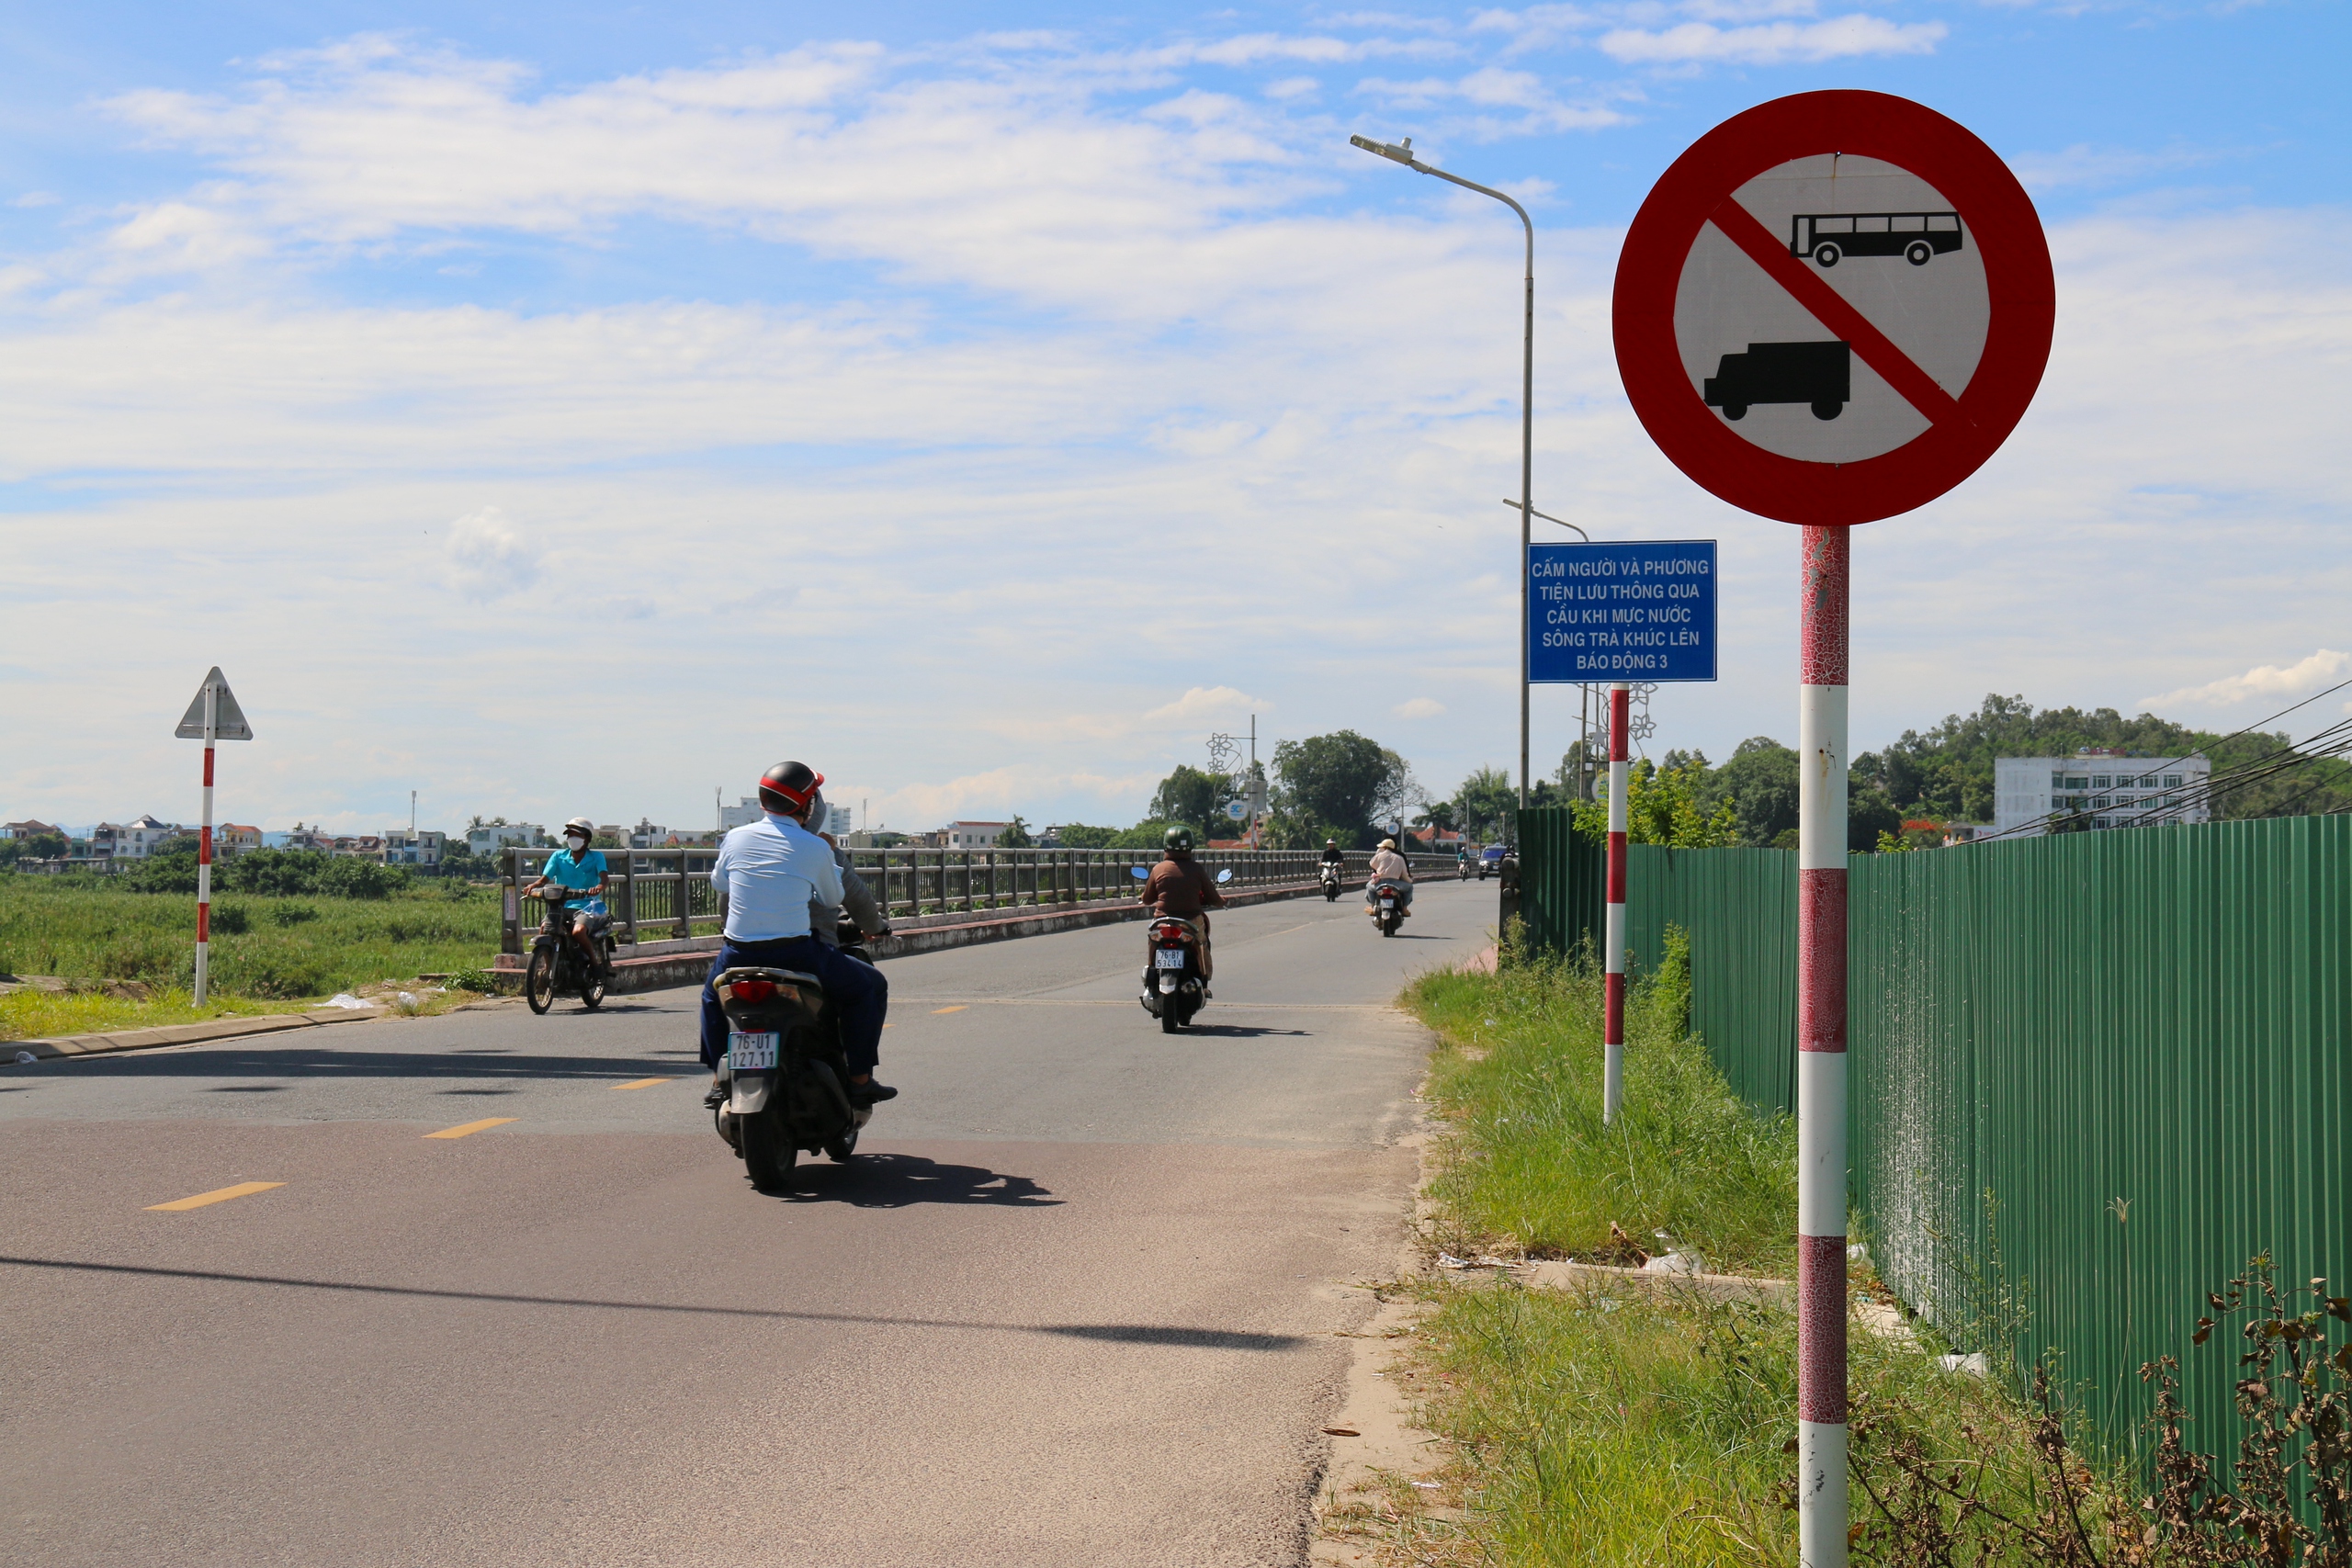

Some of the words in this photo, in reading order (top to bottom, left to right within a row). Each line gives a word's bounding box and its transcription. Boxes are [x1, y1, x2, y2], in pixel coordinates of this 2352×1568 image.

[1532, 557, 1564, 577] CẤM
[1569, 558, 1616, 576] NGƯỜI
[1621, 558, 1640, 575] VÀ
[1645, 558, 1709, 574] PHƯƠNG
[1540, 582, 1573, 604] TIỆN
[1578, 583, 1607, 600] LƯU
[1611, 581, 1663, 599] THÔNG
[1668, 584, 1700, 598] QUA
[1547, 604, 1577, 624] CẦU
[1582, 610, 1606, 623] KHI
[1612, 608, 1644, 626] MỰC
[1648, 604, 1690, 623] NƯỚC
[1543, 629, 1585, 647] SÔNG
[1589, 629, 1619, 646] TRÀ
[1624, 628, 1665, 646] KHÚC
[1670, 627, 1699, 646] LÊN
[1577, 651, 1608, 669] BÁO
[1612, 651, 1655, 673] ĐỘNG
[1659, 654, 1668, 668] 3
[737, 1034, 770, 1049] 76-U1
[732, 1051, 774, 1066] 127.11
